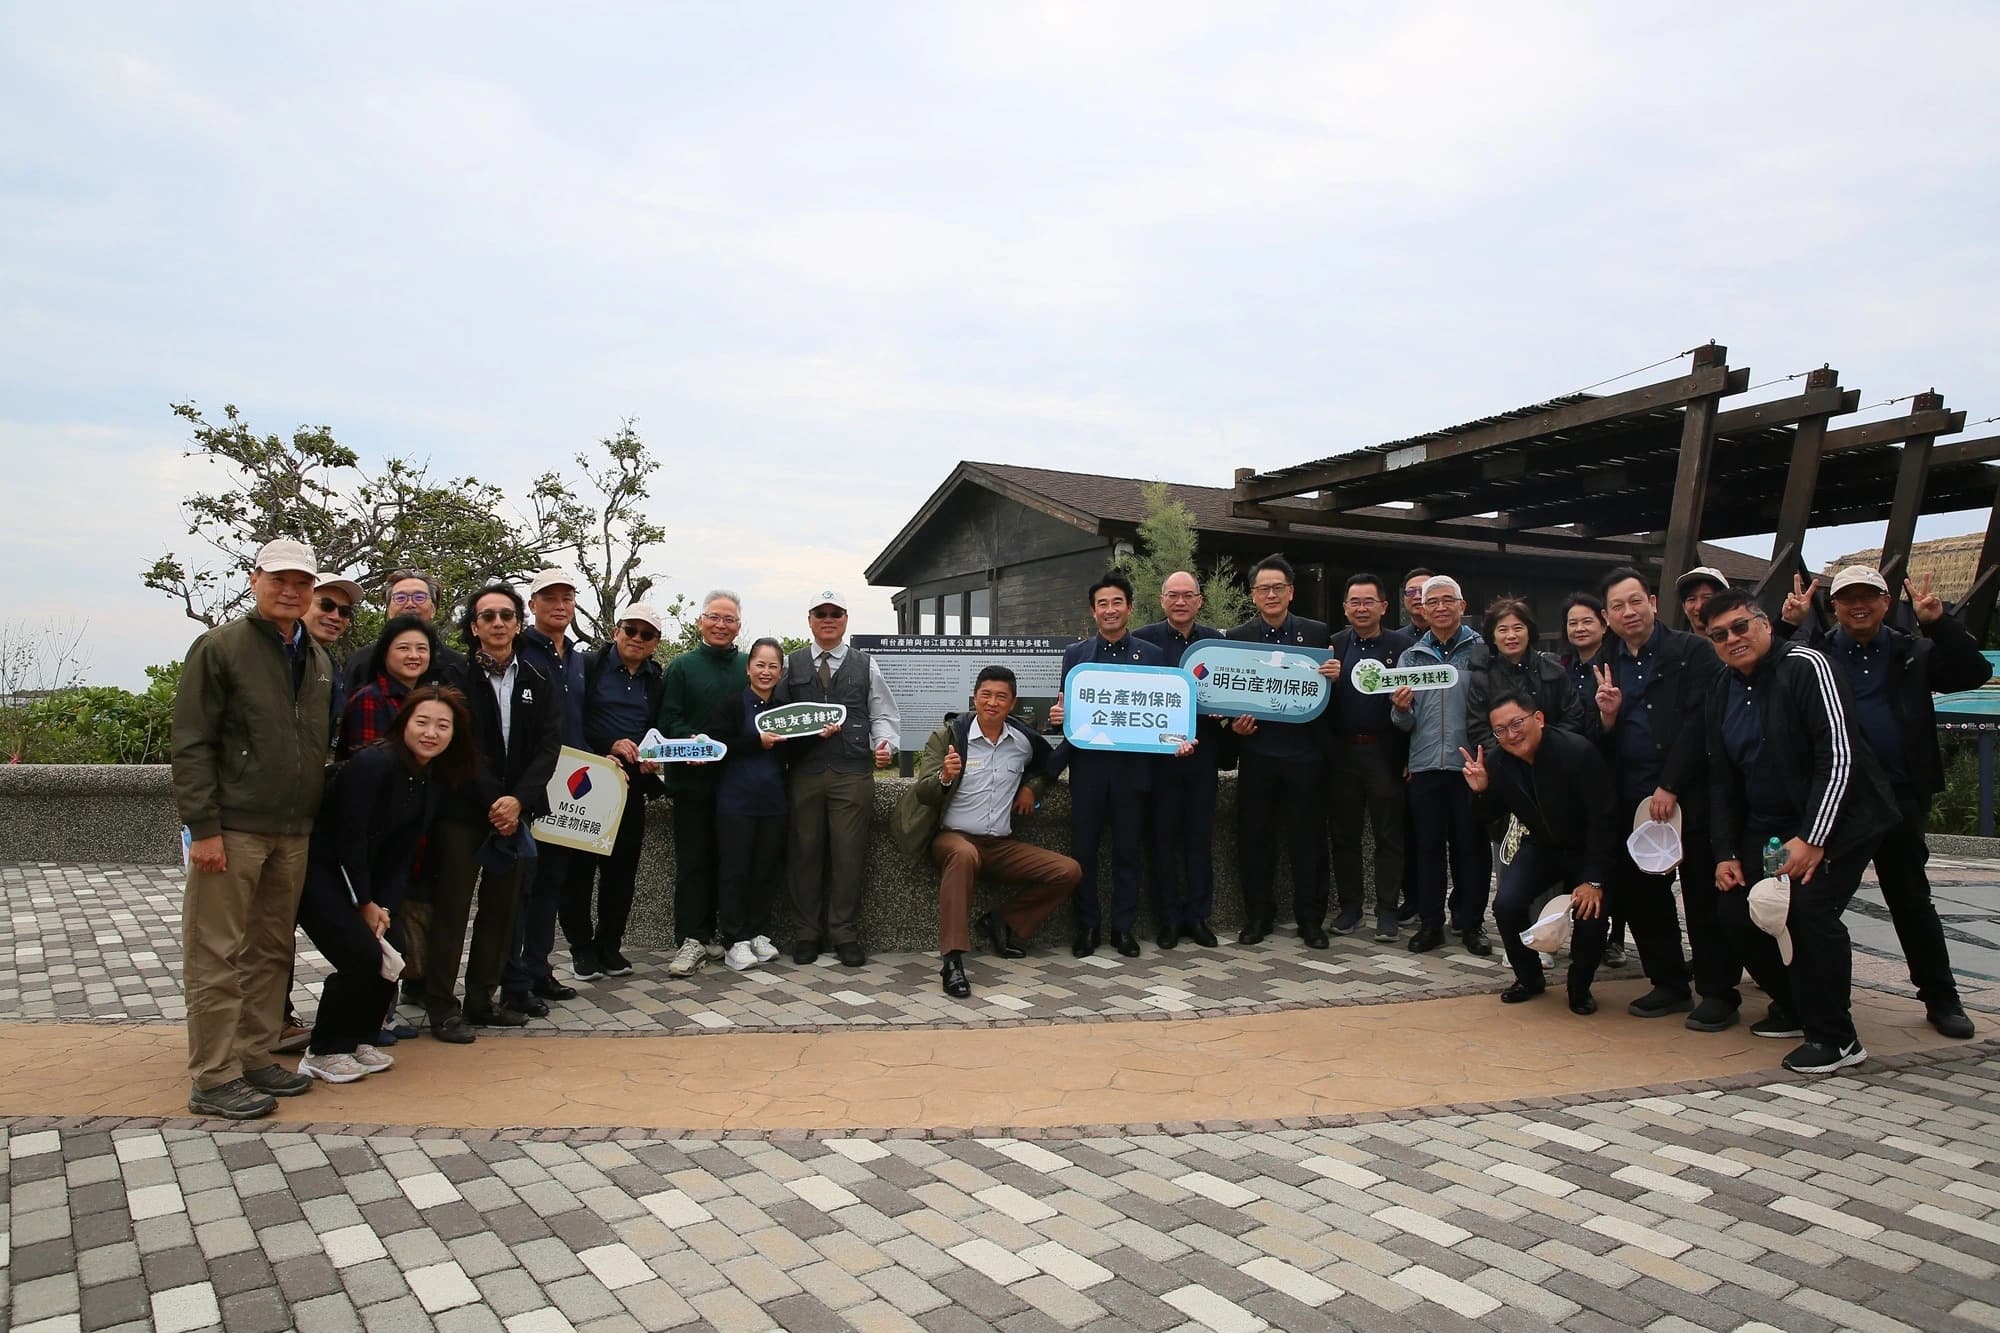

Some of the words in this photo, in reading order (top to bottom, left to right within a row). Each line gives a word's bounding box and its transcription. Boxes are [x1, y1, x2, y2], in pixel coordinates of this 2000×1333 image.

[1381, 670, 1449, 687] 生物多樣性
[1079, 688, 1182, 708] 明台產物保險
[761, 710, 840, 731] 生態友善棲地
[1091, 709, 1168, 729] 企業ESG
[659, 745, 713, 758] 棲地治理
[558, 801, 587, 816] MSIG
